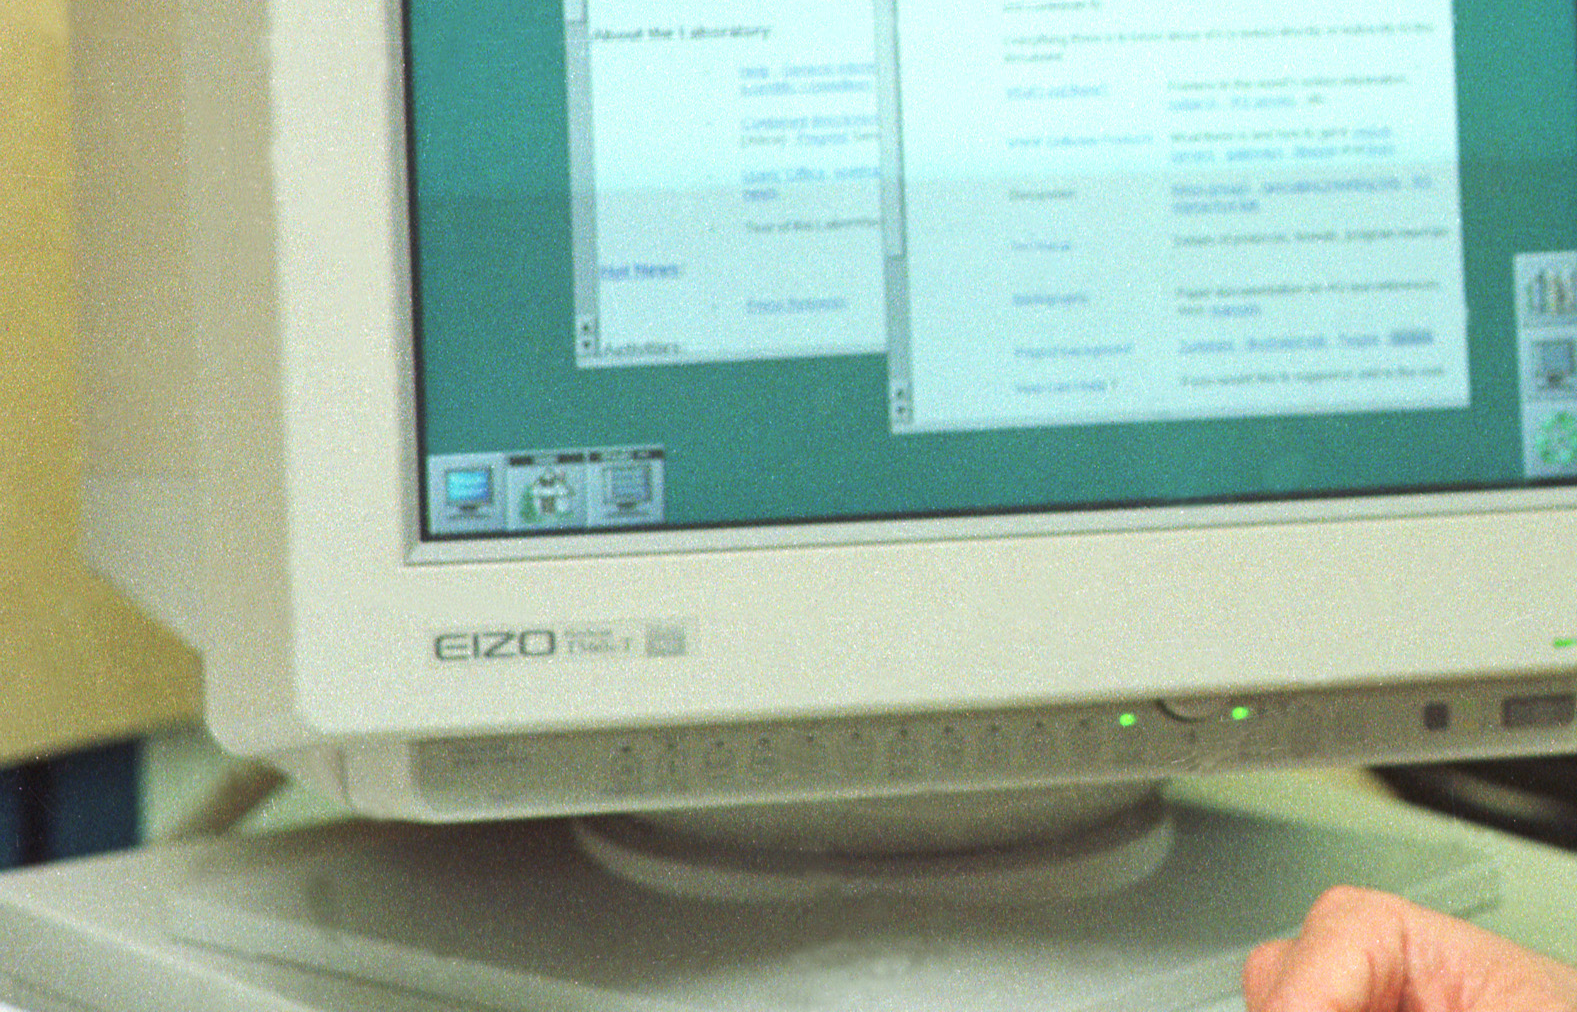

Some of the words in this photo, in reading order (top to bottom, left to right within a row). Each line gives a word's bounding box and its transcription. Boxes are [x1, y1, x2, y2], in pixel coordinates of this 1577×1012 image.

[594, 28, 642, 43] About
[648, 27, 673, 41] the
[678, 25, 772, 43] Laboratory
[434, 629, 556, 661] EIZO
